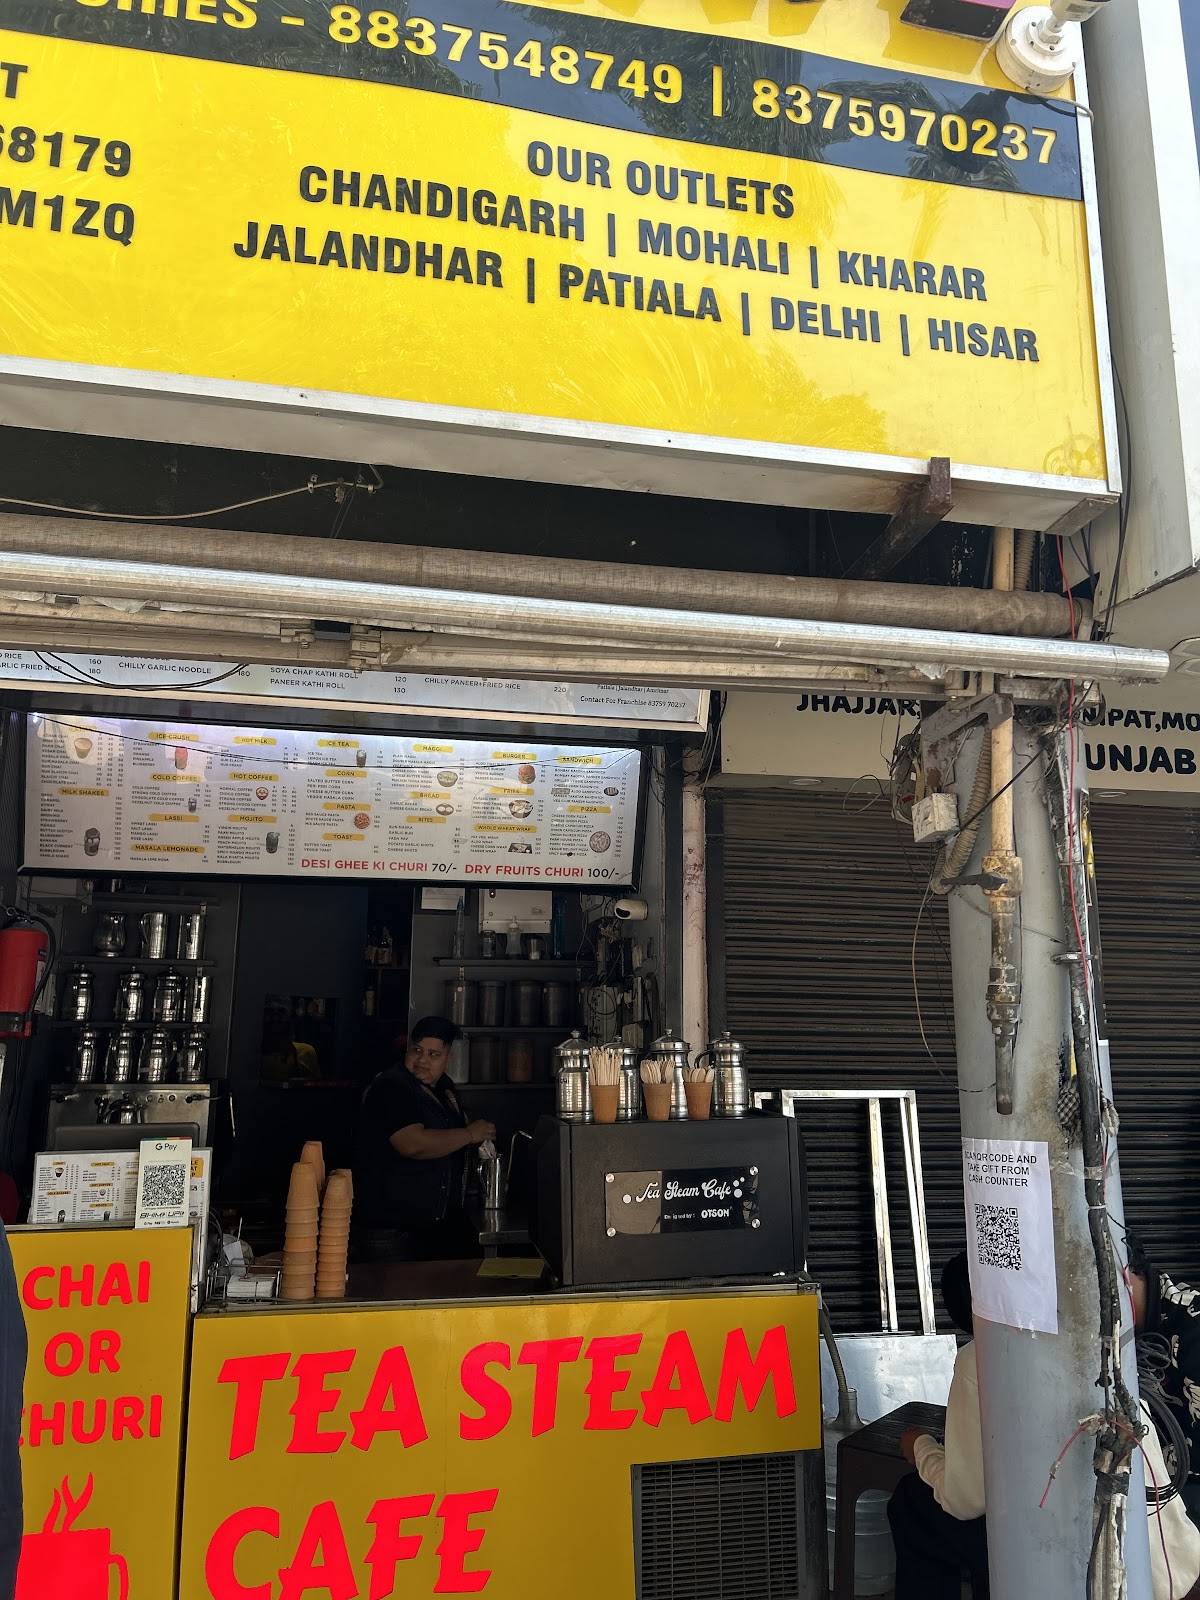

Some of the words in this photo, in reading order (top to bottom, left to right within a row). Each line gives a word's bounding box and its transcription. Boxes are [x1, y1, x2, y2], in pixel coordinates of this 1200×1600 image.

[1, 61, 29, 99] T
[329, 5, 683, 104] 8837548749
[752, 80, 1058, 164] 8375970237
[0, 124, 131, 178] 8179
[527, 140, 612, 189] OUR
[626, 160, 794, 219] OUTLETS
[299, 165, 585, 242] CHANDIGARH
[638, 218, 790, 275] MOHALI
[838, 251, 988, 302] KHARAR
[233, 221, 504, 289] JALANDHAR
[559, 263, 722, 323] PATIALA
[770, 297, 881, 343] DELHI
[928, 318, 1040, 363] HISAR
[118, 662, 145, 670] CHILLY
[147, 664, 176, 672] GARLIC
[178, 666, 212, 674] NOODLE
[270, 678, 300, 686] PANEER
[302, 680, 324, 688] KATHI
[424, 677, 449, 685] CHILLY
[580, 695, 604, 703] Contact
[302, 858, 330, 869] DESI
[334, 860, 369, 870] GHEE
[373, 862, 385, 871] KI
[389, 862, 428, 872] CHURI
[432, 864, 457, 874] 70/-
[465, 864, 492, 874] DRY
[496, 866, 541, 876] FRUITS
[544, 866, 584, 878] CHURI
[588, 868, 620, 880] 100/-
[164, 1143, 178, 1152] Pay
[1017, 1155, 1037, 1164] AND
[968, 1174, 982, 1184] CASH
[985, 1176, 1028, 1187] COUNTER
[982, 1164, 999, 1174] GIFT
[1002, 1166, 1030, 1176] FROM
[636, 1182, 660, 1202] Tea
[664, 1181, 700, 1200] Steam
[701, 1178, 732, 1200] Cafe
[24, 1260, 151, 1311] CHAI
[44, 1330, 122, 1377] OR
[218, 1346, 430, 1461] TEA
[459, 1326, 798, 1441] STEAM
[19, 1395, 164, 1446] HURI
[204, 1487, 499, 1600] CAFE
